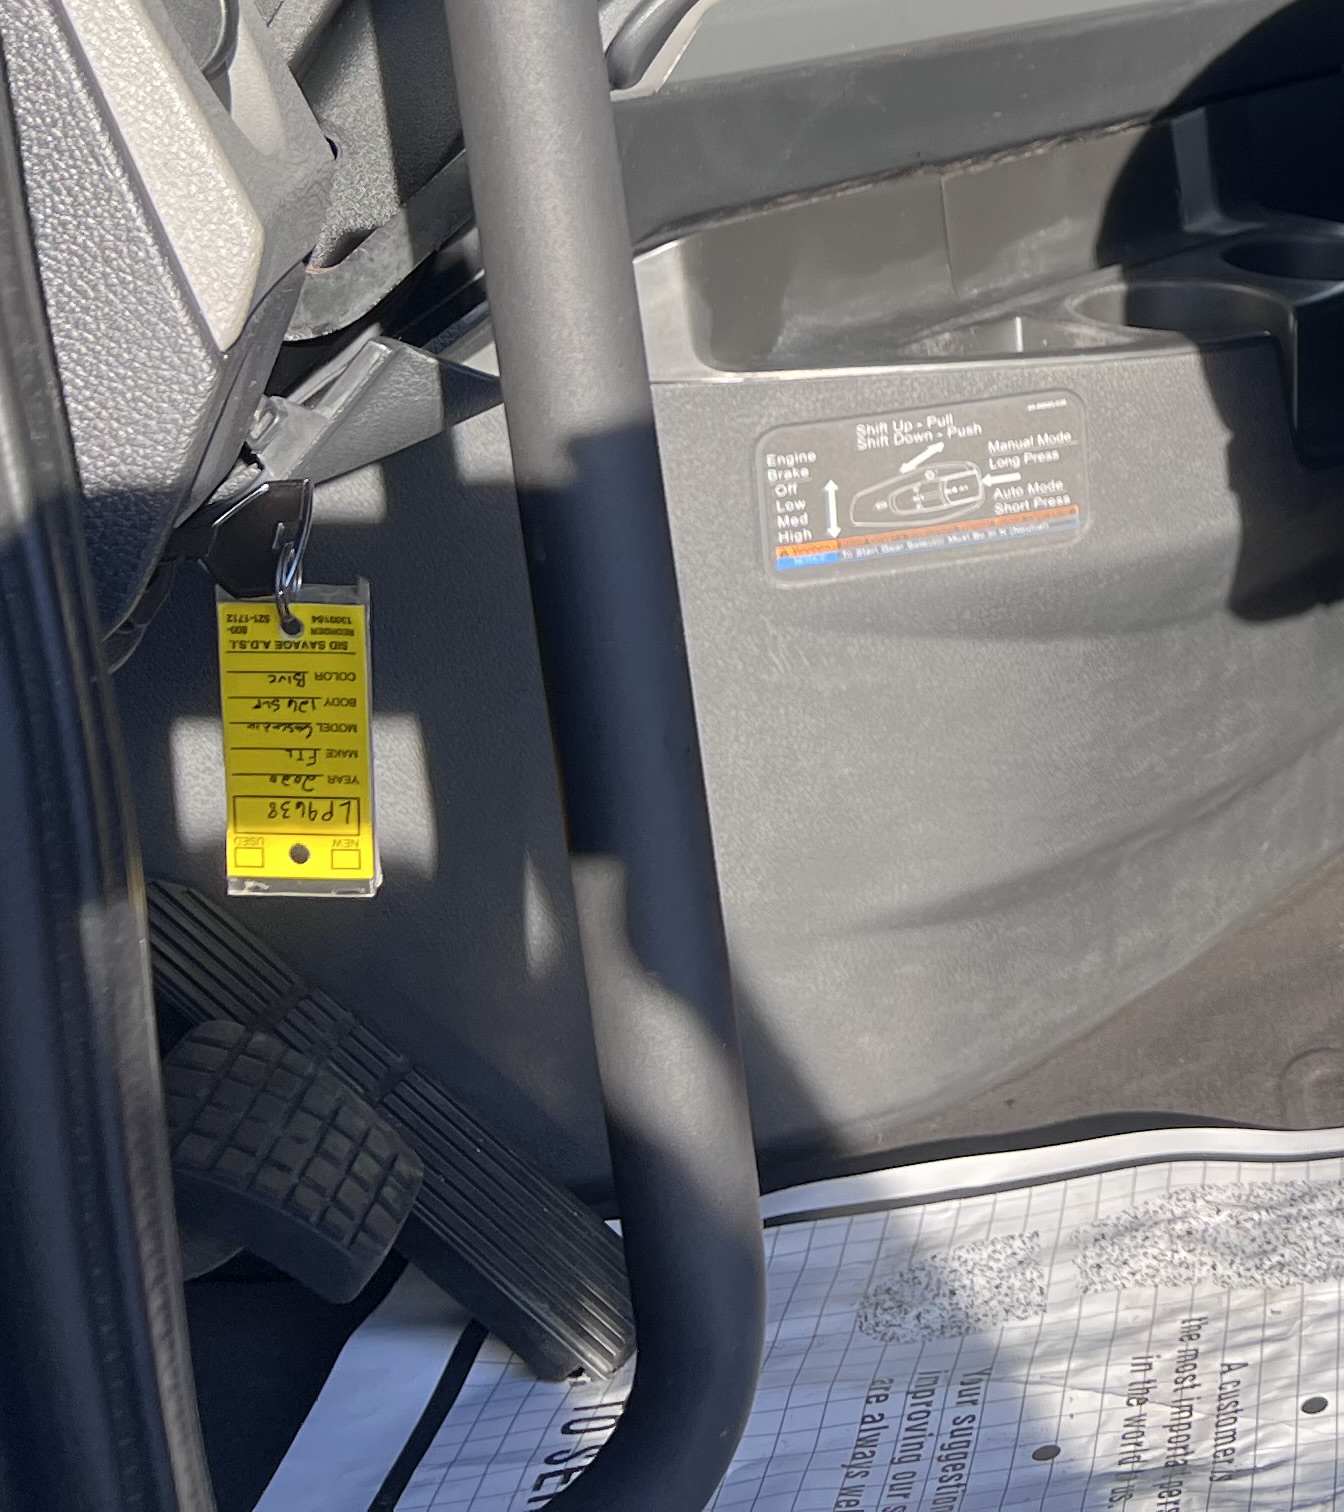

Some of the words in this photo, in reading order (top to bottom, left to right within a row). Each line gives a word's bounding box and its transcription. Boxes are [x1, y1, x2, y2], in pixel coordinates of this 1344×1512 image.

[856, 421, 888, 436] Shift
[892, 419, 913, 433] Up
[927, 413, 953, 428] Pull
[856, 434, 889, 450] Shift
[894, 430, 933, 445] Down
[948, 422, 982, 438] Push
[988, 436, 1034, 454] Manual
[1037, 430, 1072, 445] Mode
[766, 451, 816, 467] Engine
[989, 455, 1021, 469] Long
[1024, 449, 1060, 463] Press
[767, 467, 809, 482] Brake
[775, 482, 797, 497] Off
[993, 485, 1025, 500] Auto
[1028, 480, 1064, 495] Mode
[776, 499, 806, 513] Low
[994, 499, 1030, 515] Short
[1033, 494, 1071, 509] Press
[777, 513, 808, 528] Med
[778, 528, 812, 544] High
[275, 640, 326, 650] SAVAGE
[315, 672, 356, 681] COLOR
[324, 698, 356, 707] BODY
[319, 723, 357, 732] MODEL
[326, 749, 358, 758] MAKE
[269, 774, 317, 792] 2020
[328, 775, 360, 784] YEAR
[268, 800, 351, 824] LP9638
[233, 836, 265, 846] USED
[332, 838, 359, 848] NEW
[1178, 1316, 1209, 1342] the
[1130, 1354, 1162, 1374] in
[1173, 1348, 1202, 1393] most
[1220, 1362, 1249, 1376] A
[866, 1378, 894, 1405] are
[955, 1366, 993, 1406] Your
[1126, 1378, 1158, 1407] the
[1211, 1380, 1245, 1465] customer
[841, 1412, 889, 1479] always
[1117, 1412, 1151, 1466] world
[887, 1470, 917, 1499] our
